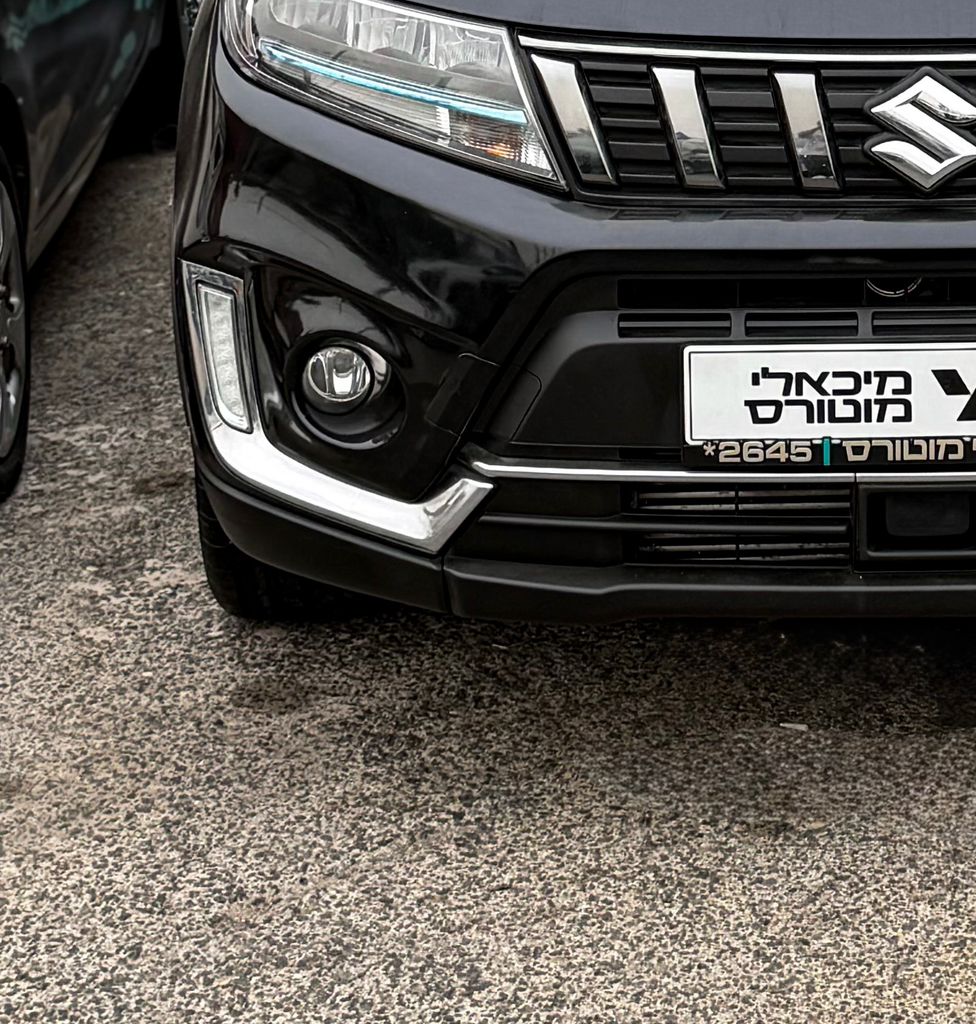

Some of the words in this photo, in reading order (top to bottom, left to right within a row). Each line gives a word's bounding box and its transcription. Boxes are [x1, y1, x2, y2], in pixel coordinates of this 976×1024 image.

[751, 367, 913, 396] מיכאלי
[744, 398, 913, 424] מוטורס
[842, 439, 964, 462] מוטורס
